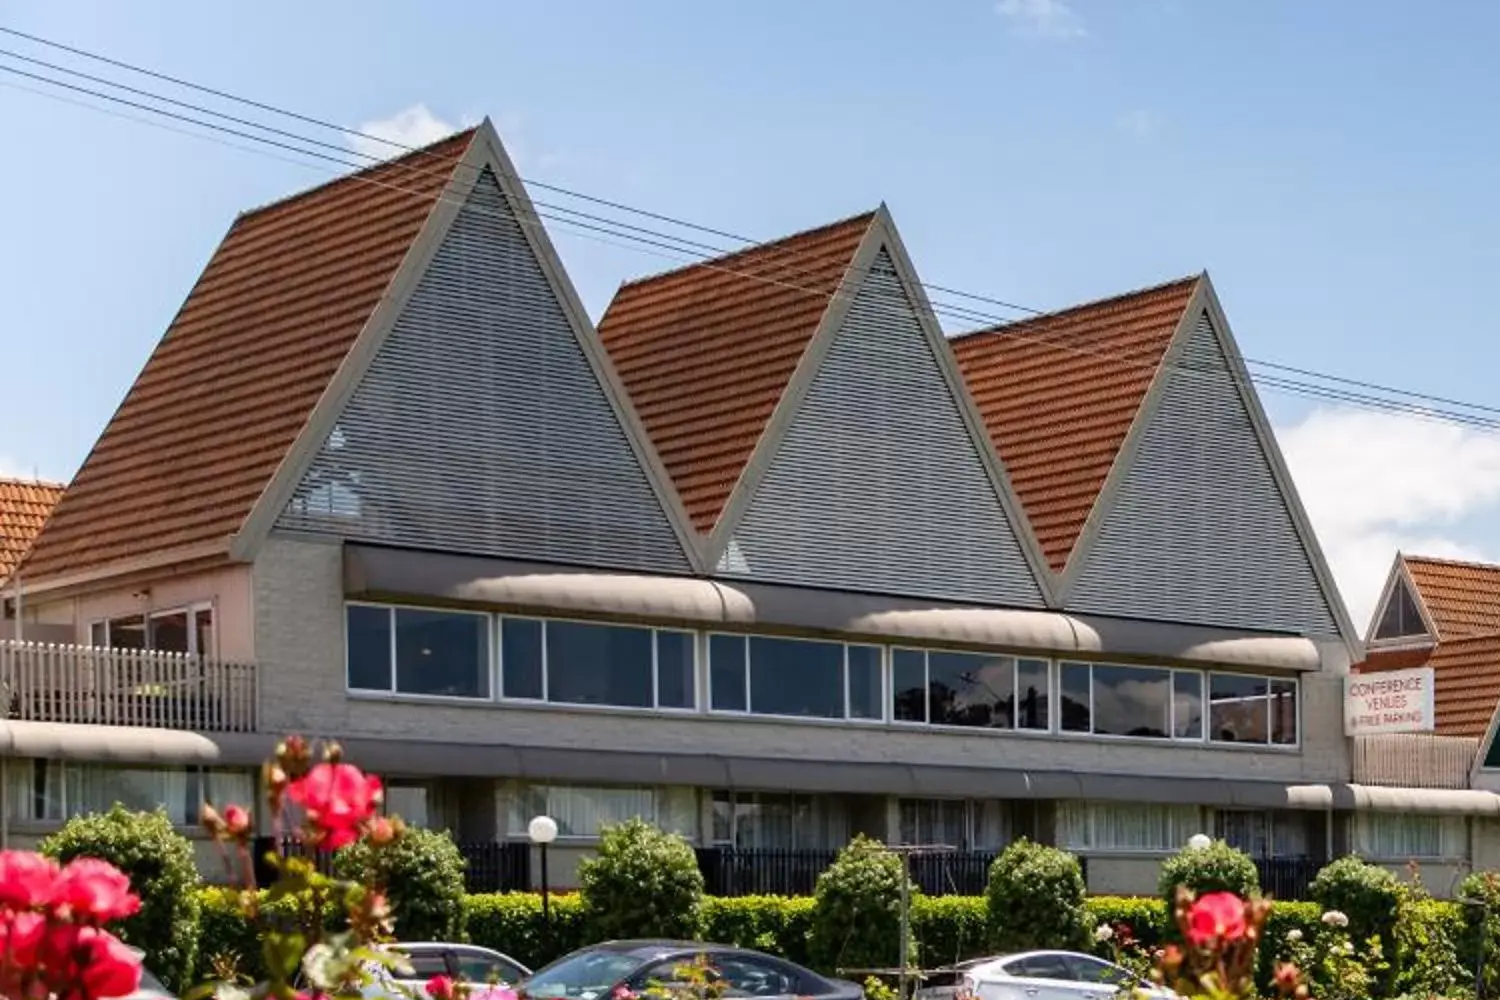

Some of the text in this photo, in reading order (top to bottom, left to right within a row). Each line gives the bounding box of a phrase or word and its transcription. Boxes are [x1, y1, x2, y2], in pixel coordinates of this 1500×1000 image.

[1350, 677, 1422, 697] CONFERENCE
[1365, 694, 1407, 711] VENUES
[1383, 710, 1422, 723] PARKING
